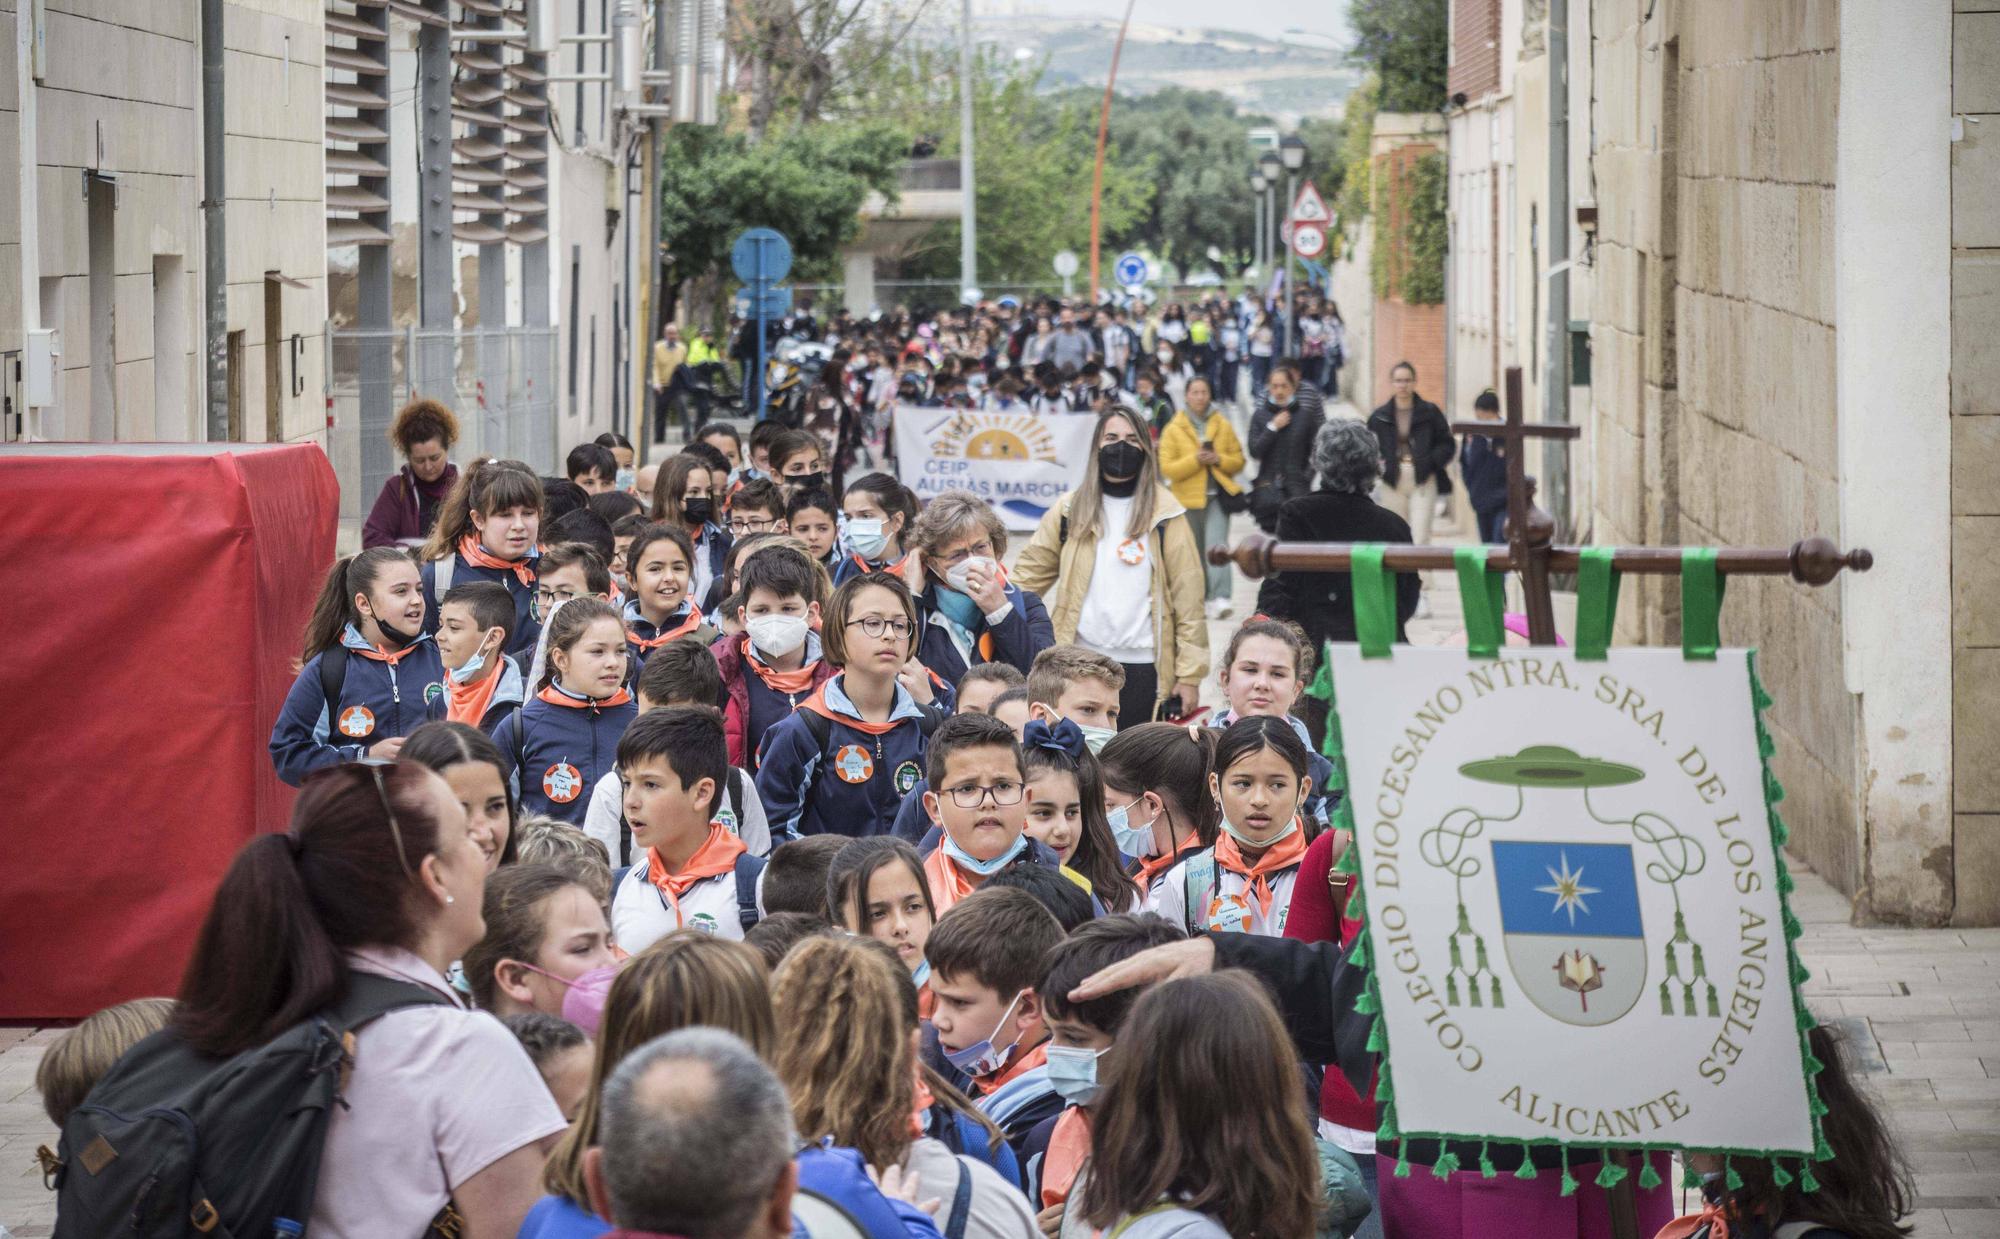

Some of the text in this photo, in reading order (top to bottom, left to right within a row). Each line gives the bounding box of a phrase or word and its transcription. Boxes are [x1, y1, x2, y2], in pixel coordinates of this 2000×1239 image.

[995, 480, 1069, 498] MARCH
[1373, 658, 1768, 1087] COLEGIO DIOCESANO NTRA. SRA. DE LOS ANGELES
[1498, 1084, 1691, 1138] ALICANTE
